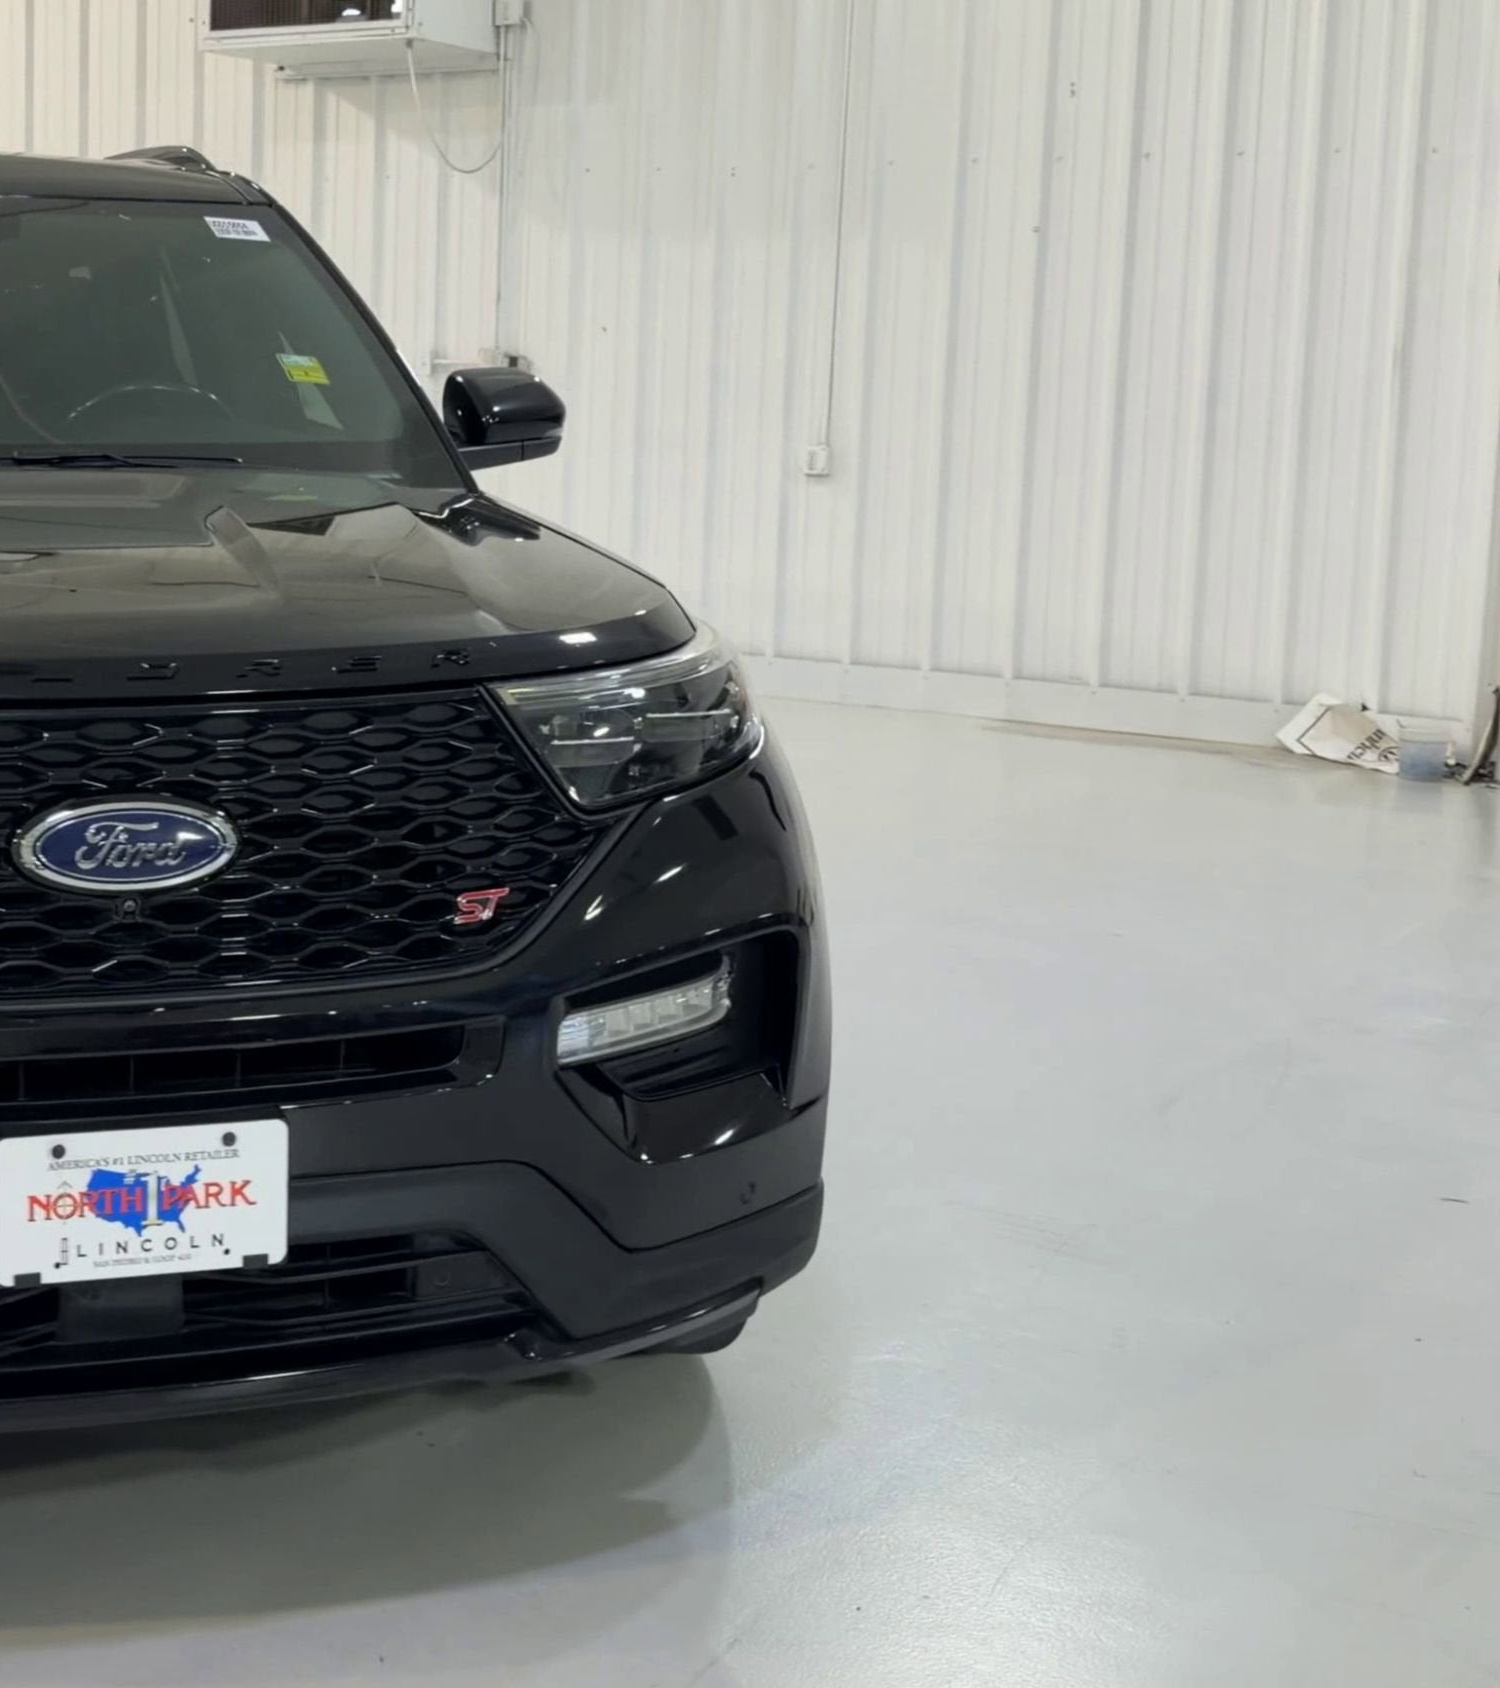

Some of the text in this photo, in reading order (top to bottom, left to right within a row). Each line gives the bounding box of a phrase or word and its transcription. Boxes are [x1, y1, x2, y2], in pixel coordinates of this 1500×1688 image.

[74, 821, 188, 870] Ford
[453, 887, 510, 925] ST
[127, 1152, 181, 1165] LINCOLN
[27, 1179, 257, 1222] NORTH PARK
[76, 1233, 225, 1258] LINCOLN
